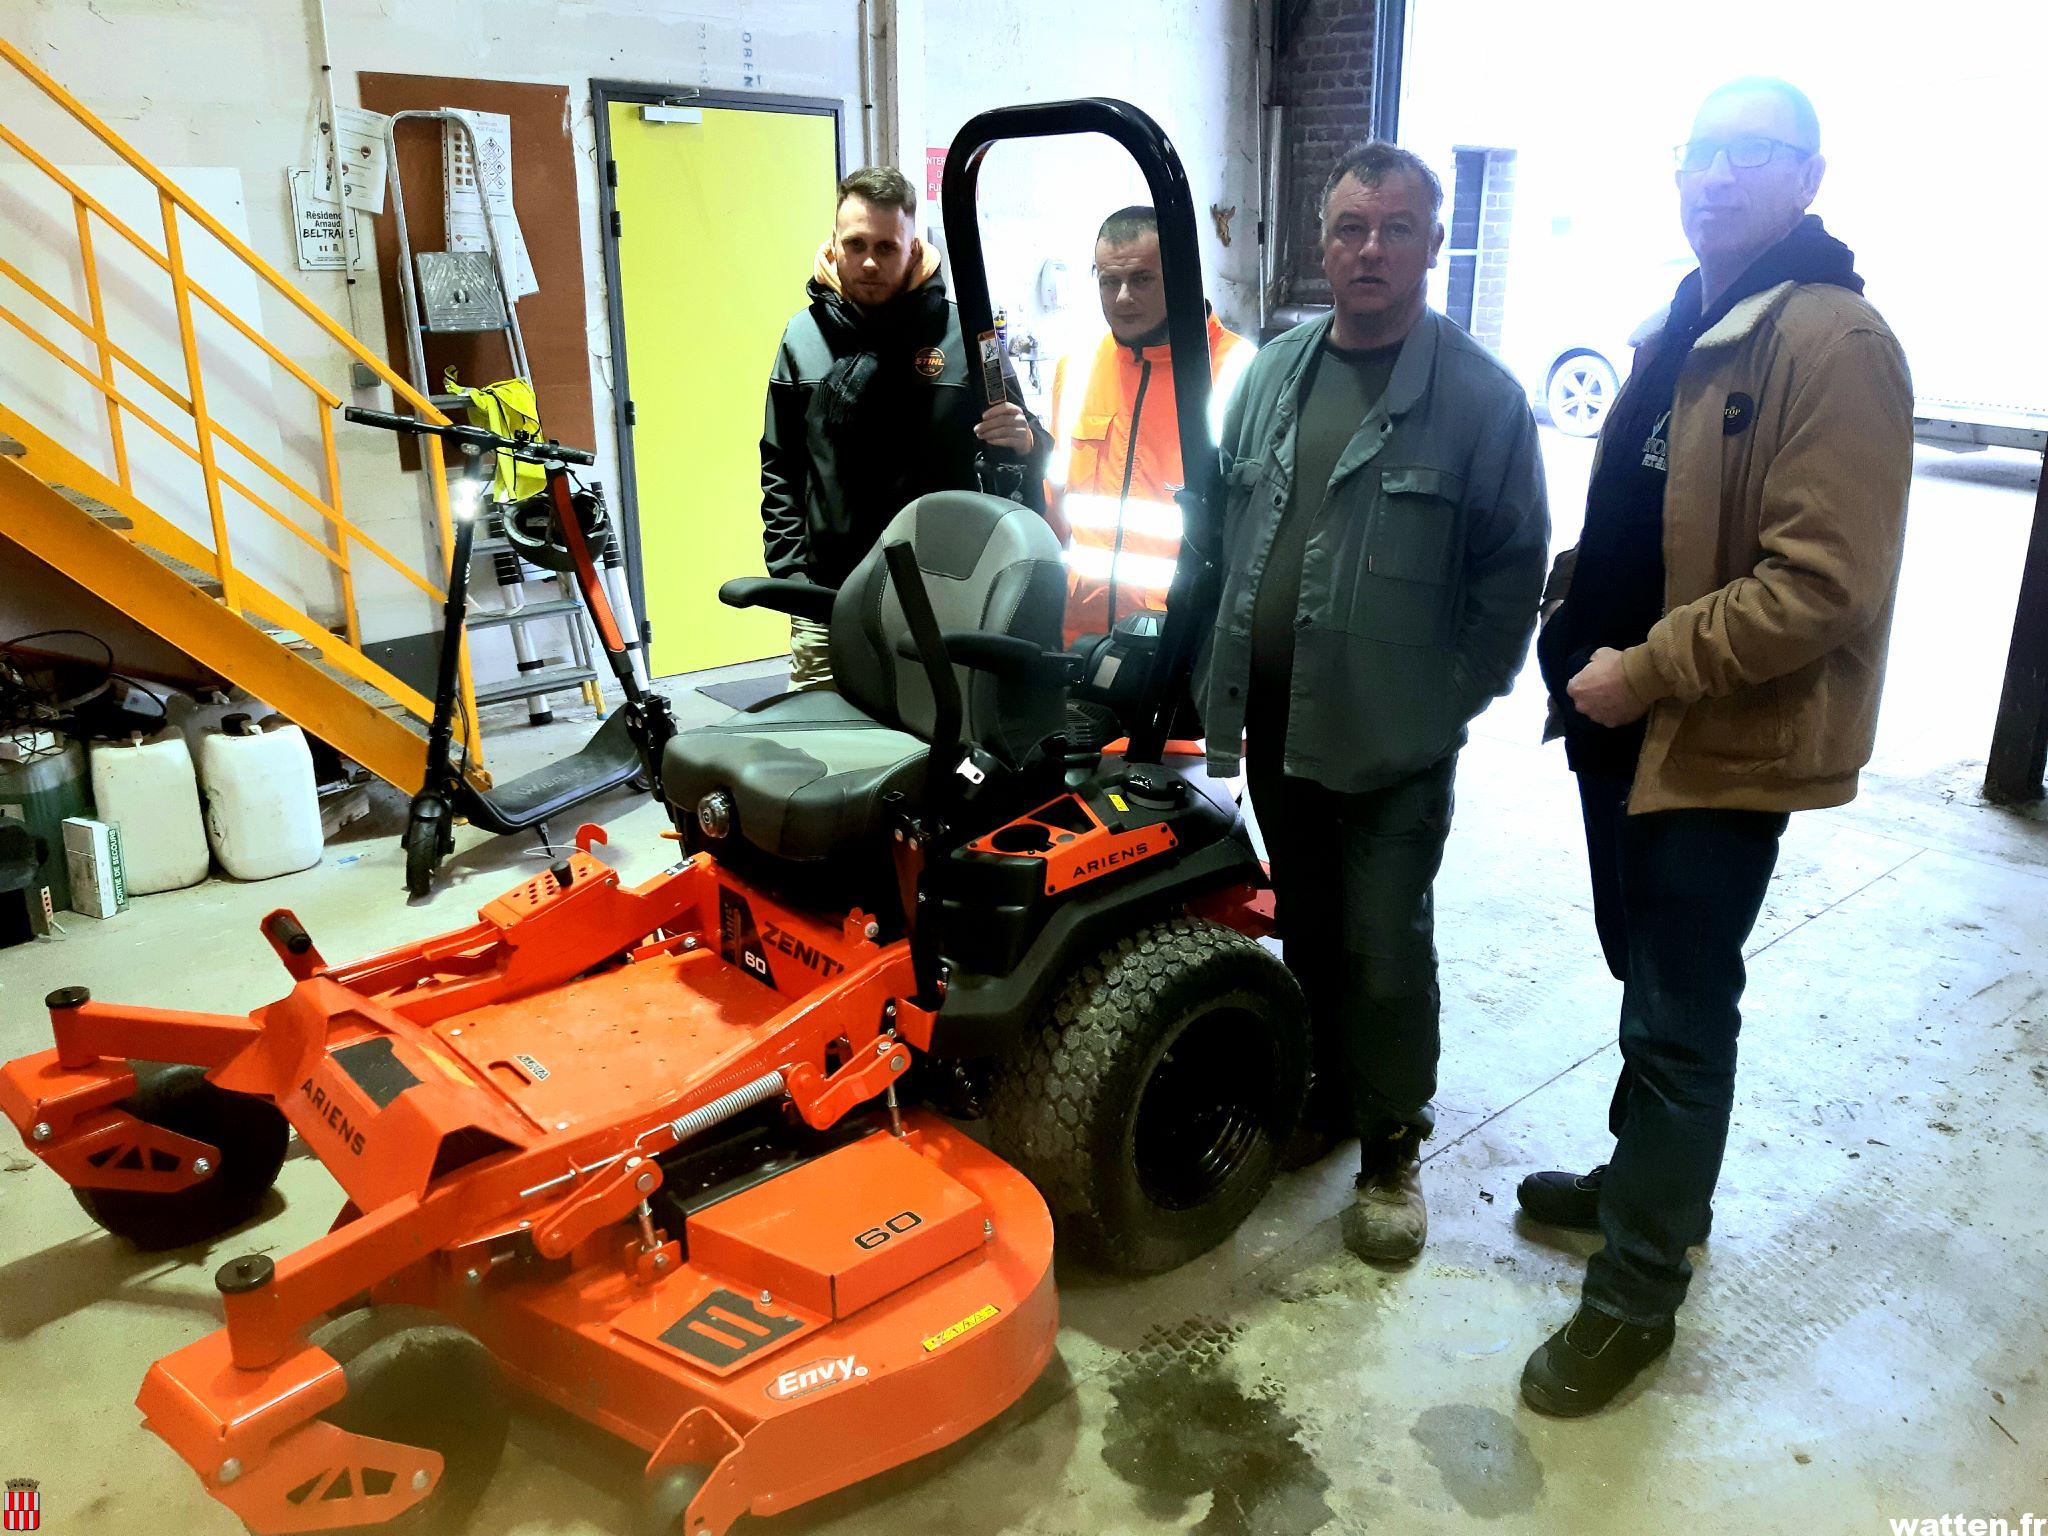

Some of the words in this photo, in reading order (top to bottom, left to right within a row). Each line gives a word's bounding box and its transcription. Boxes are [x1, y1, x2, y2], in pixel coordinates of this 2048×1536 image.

[306, 211, 341, 220] Résidenc
[303, 228, 355, 239] BELTRAE
[915, 357, 944, 366] STIHL
[109, 829, 121, 865] SECOURS
[114, 866, 122, 877] DE
[1073, 843, 1148, 879] ARIENS
[115, 879, 124, 905] SORTIE
[744, 950, 766, 974] 60
[301, 1078, 366, 1156] ARIENS
[854, 1211, 923, 1250] 60
[777, 1356, 856, 1396] Envy
